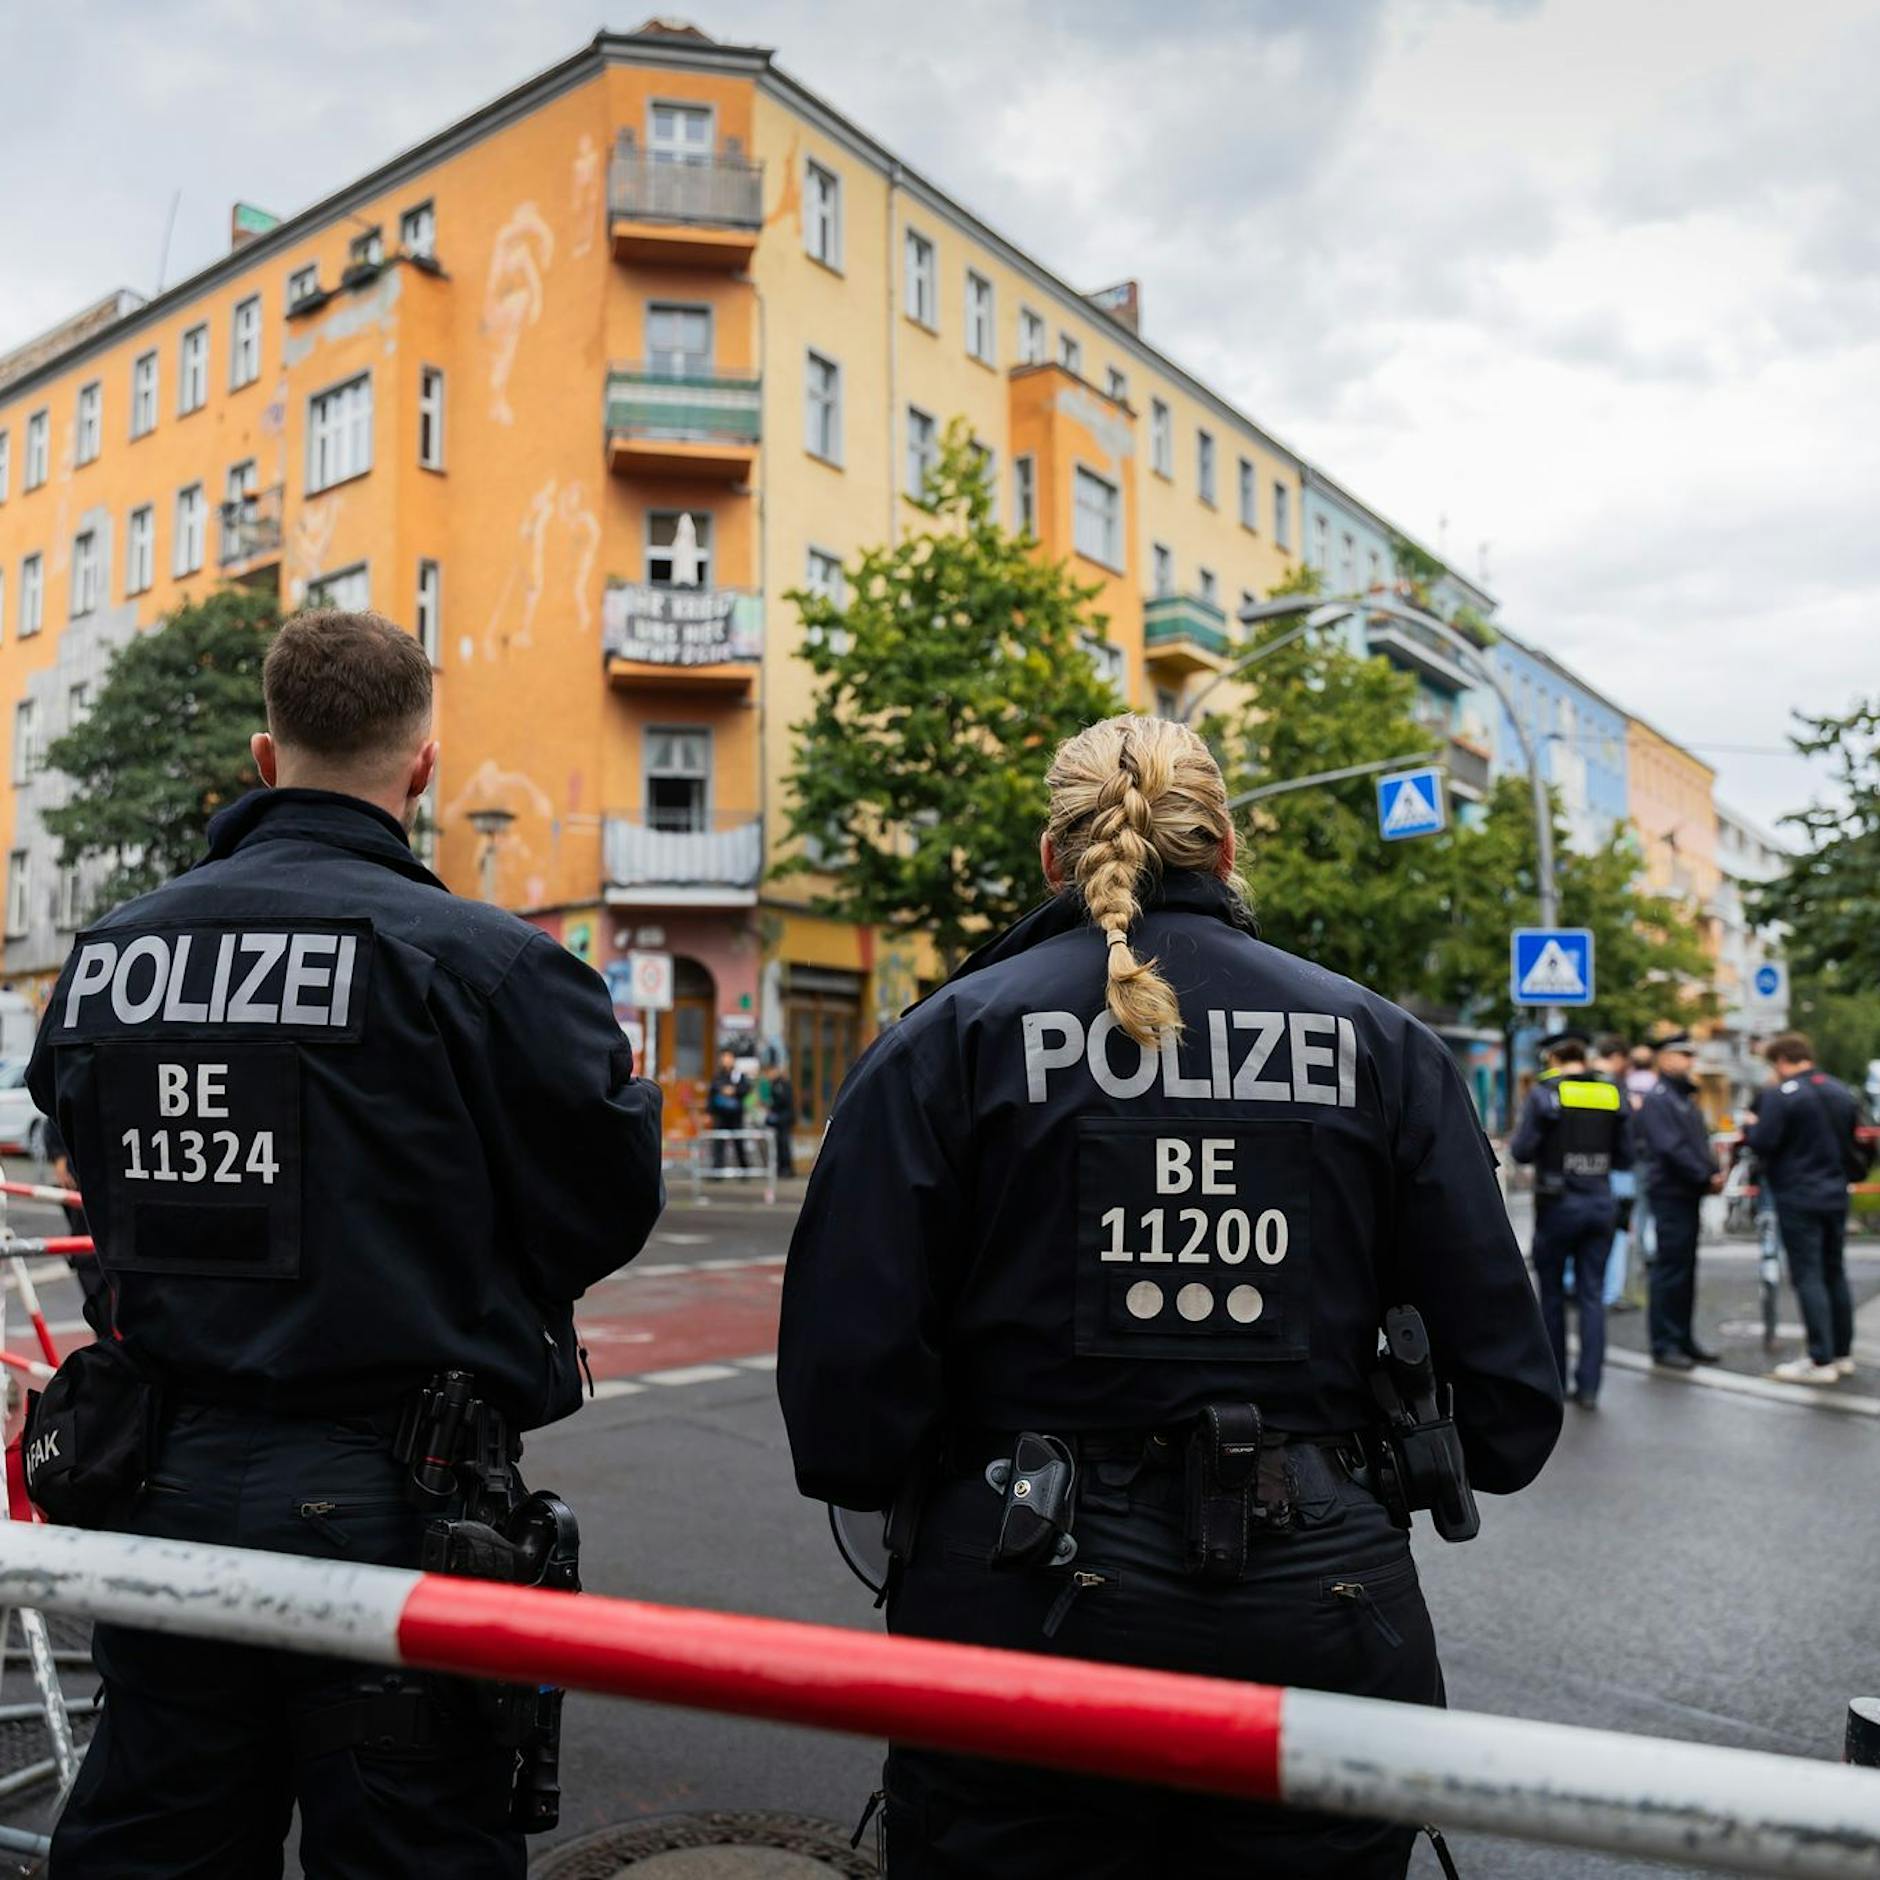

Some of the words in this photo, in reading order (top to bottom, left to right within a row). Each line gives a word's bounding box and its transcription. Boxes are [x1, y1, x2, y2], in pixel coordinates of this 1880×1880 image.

[64, 932, 357, 1029] POLIZEI
[1022, 1010, 1357, 1108] POLIZEI
[158, 1063, 229, 1118] BE
[121, 1128, 280, 1184] 11324
[1156, 1138, 1237, 1195] BE
[1100, 1207, 1289, 1265] 11200
